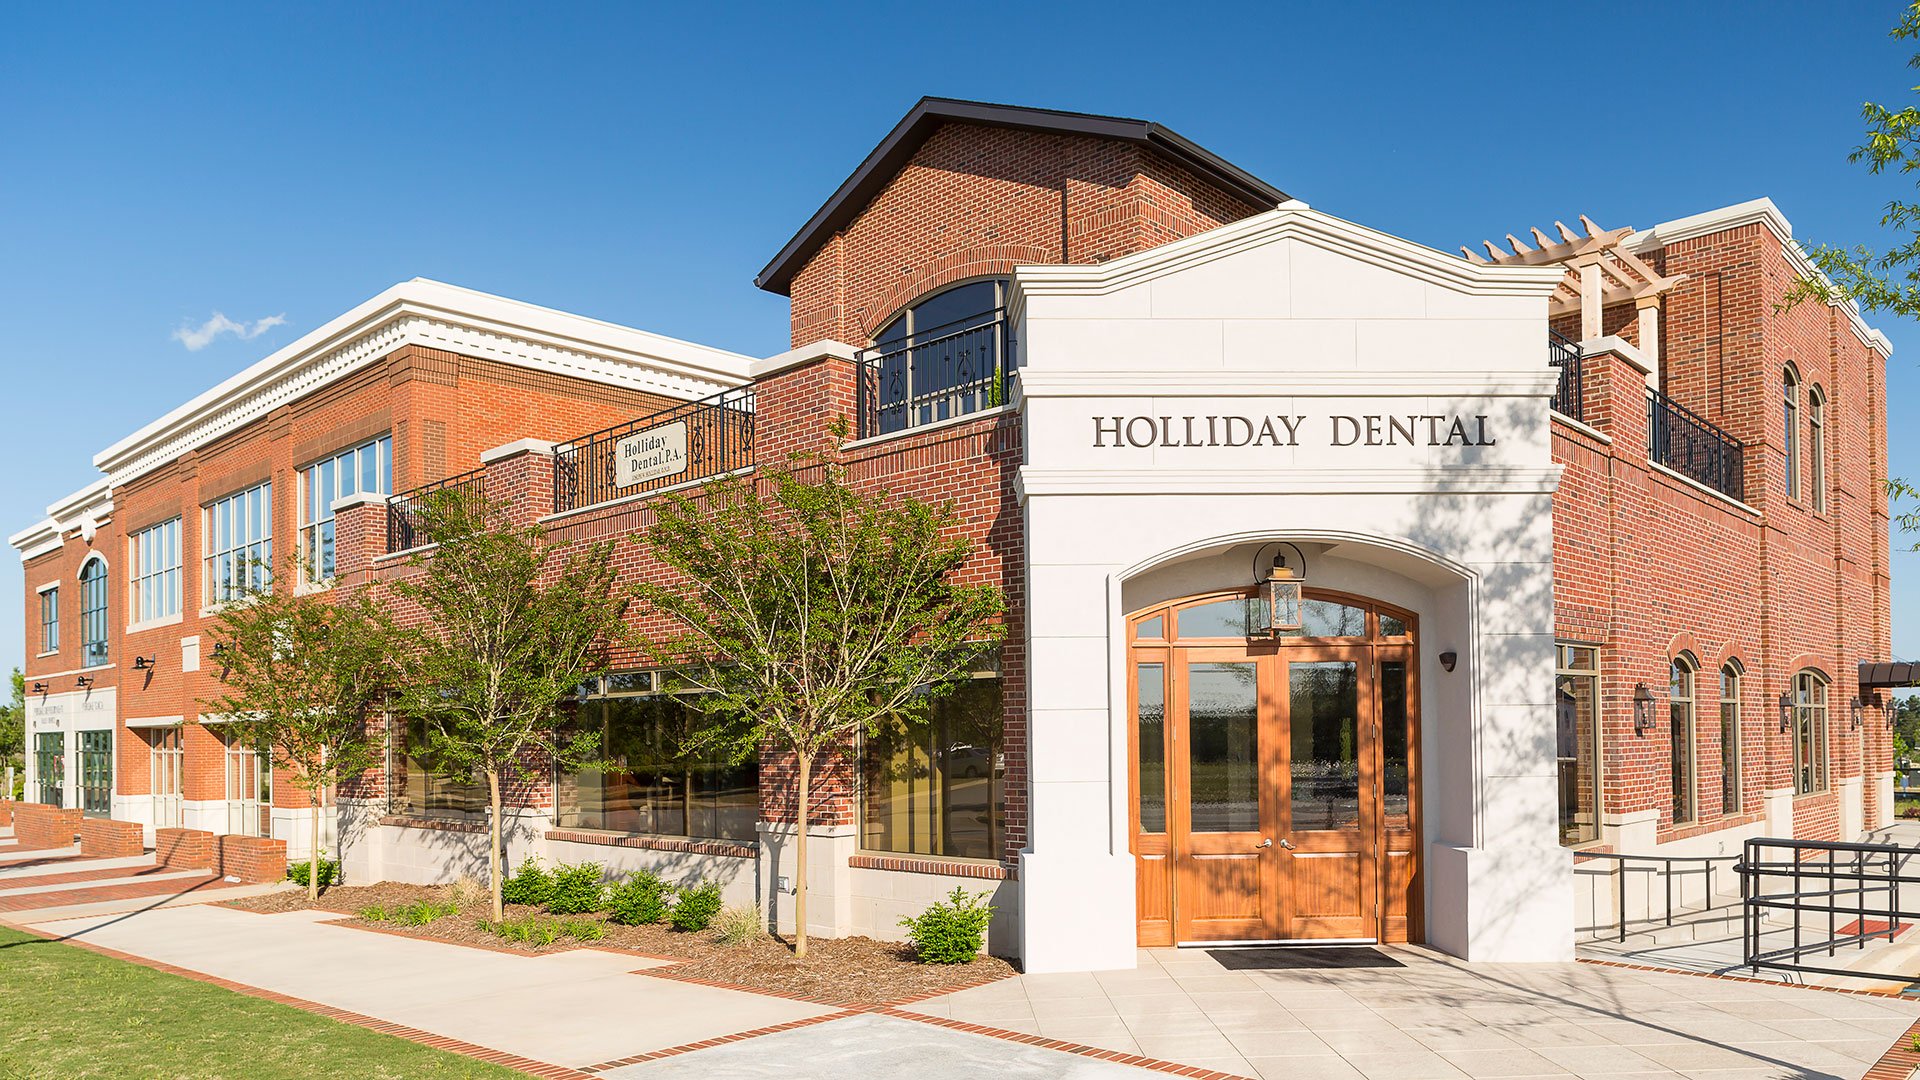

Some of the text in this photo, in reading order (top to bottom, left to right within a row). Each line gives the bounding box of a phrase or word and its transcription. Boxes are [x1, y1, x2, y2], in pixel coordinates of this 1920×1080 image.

[1092, 414, 1496, 448] HOLLIDAY DENTAL
[624, 436, 667, 459] Holliday
[665, 447, 682, 463] P.A.
